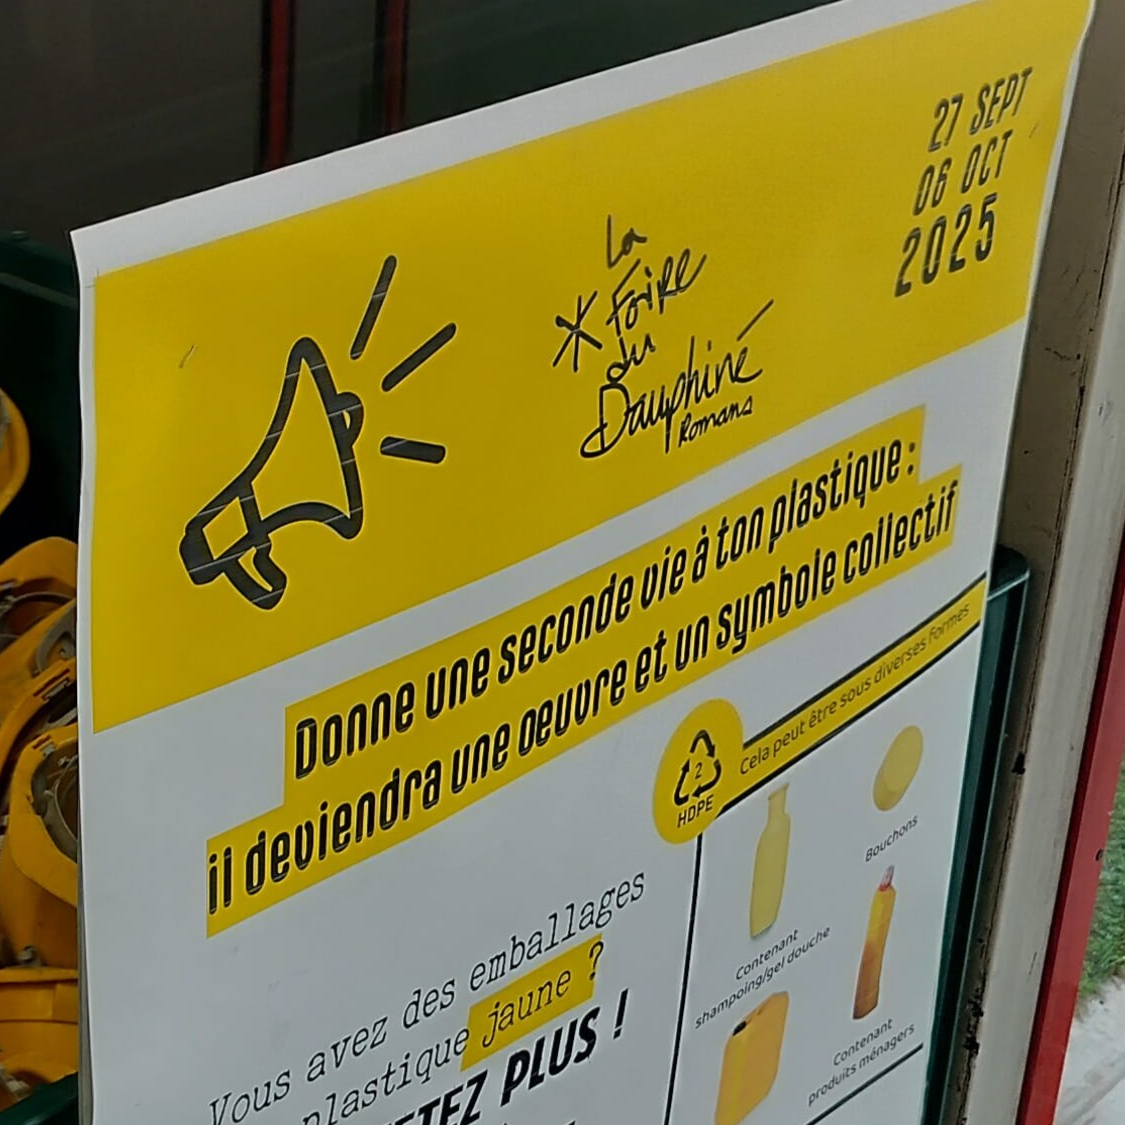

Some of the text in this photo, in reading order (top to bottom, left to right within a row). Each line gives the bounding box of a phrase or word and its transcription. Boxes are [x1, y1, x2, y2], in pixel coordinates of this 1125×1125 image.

[928, 66, 1033, 152] 27 SEPT
[913, 129, 1013, 216] 06 OCT
[895, 193, 997, 297] 2025
[580, 299, 774, 458] Dauphiné
[607, 333, 656, 383] du
[678, 396, 753, 448] Romans
[295, 681, 415, 779] Donne
[426, 647, 490, 720] une
[498, 572, 634, 684] seconde
[640, 545, 686, 610] vie
[692, 524, 709, 583] à
[715, 506, 764, 570] ton
[209, 846, 232, 915] il
[245, 759, 441, 895] deviendra
[451, 722, 510, 794] une
[635, 630, 667, 692] et
[675, 615, 709, 672] un
[717, 548, 837, 655] symbole
[843, 479, 958, 584] collectif
[740, 604, 970, 775] Cela peut être sous diverses formes
[677, 794, 714, 828] HDPE
[695, 763, 702, 779] 2
[866, 816, 918, 862] Bouchons
[307, 1017, 388, 1083] avez
[402, 979, 456, 1031] des
[470, 872, 645, 991] emballages
[695, 927, 830, 1029] shampoing/gel douche
[736, 929, 799, 981] Contenant
[482, 969, 571, 1048] jaune
[833, 1018, 893, 1066] Contenant
[500, 1007, 601, 1107] PLUS
[808, 1024, 915, 1107] produits ménagers
